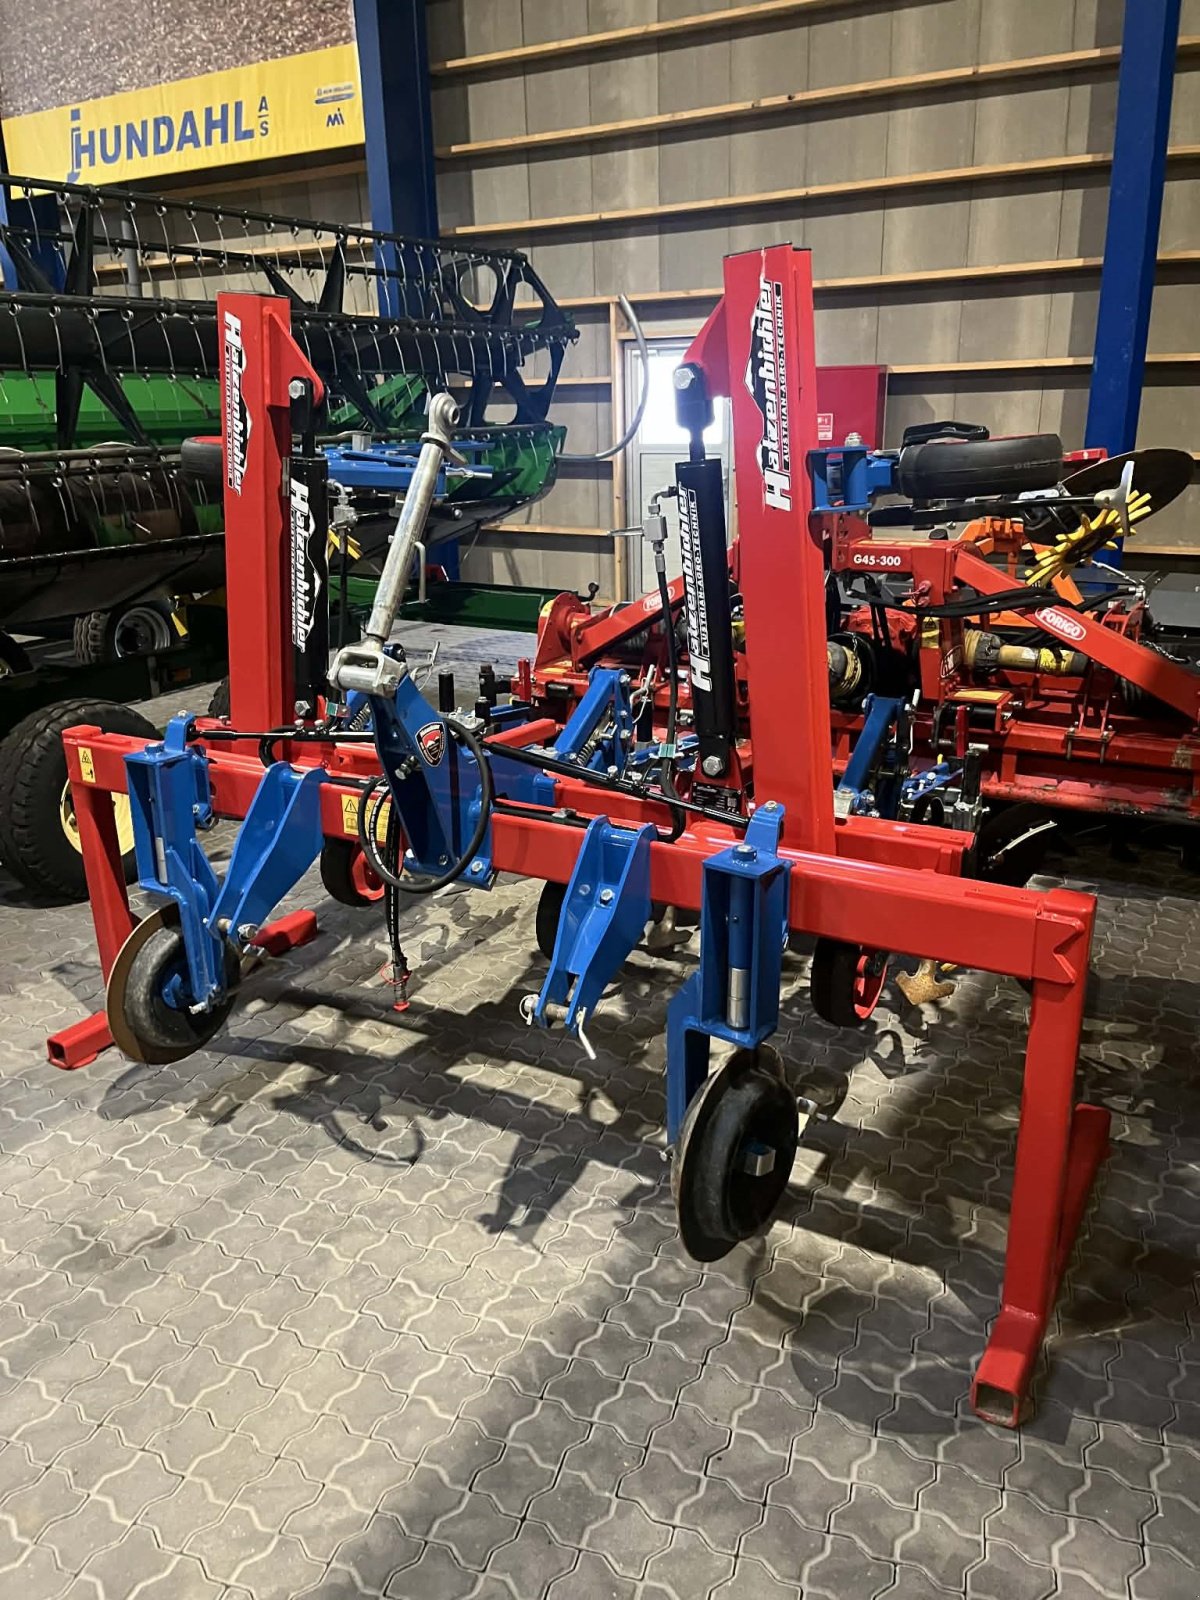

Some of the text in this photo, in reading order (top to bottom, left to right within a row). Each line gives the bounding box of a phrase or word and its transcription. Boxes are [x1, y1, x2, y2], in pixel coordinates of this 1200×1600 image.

[224, 311, 245, 496] Hatzenbichler
[756, 278, 792, 512] Hatzenbichler
[776, 295, 790, 463] AUSTRIAN-AGRO-TECHNIK
[290, 477, 311, 653] Hatzenbichler
[677, 484, 713, 692] Hatzenbichler
[853, 554, 901, 566] G45-300
[1040, 608, 1080, 637] FORIGO
